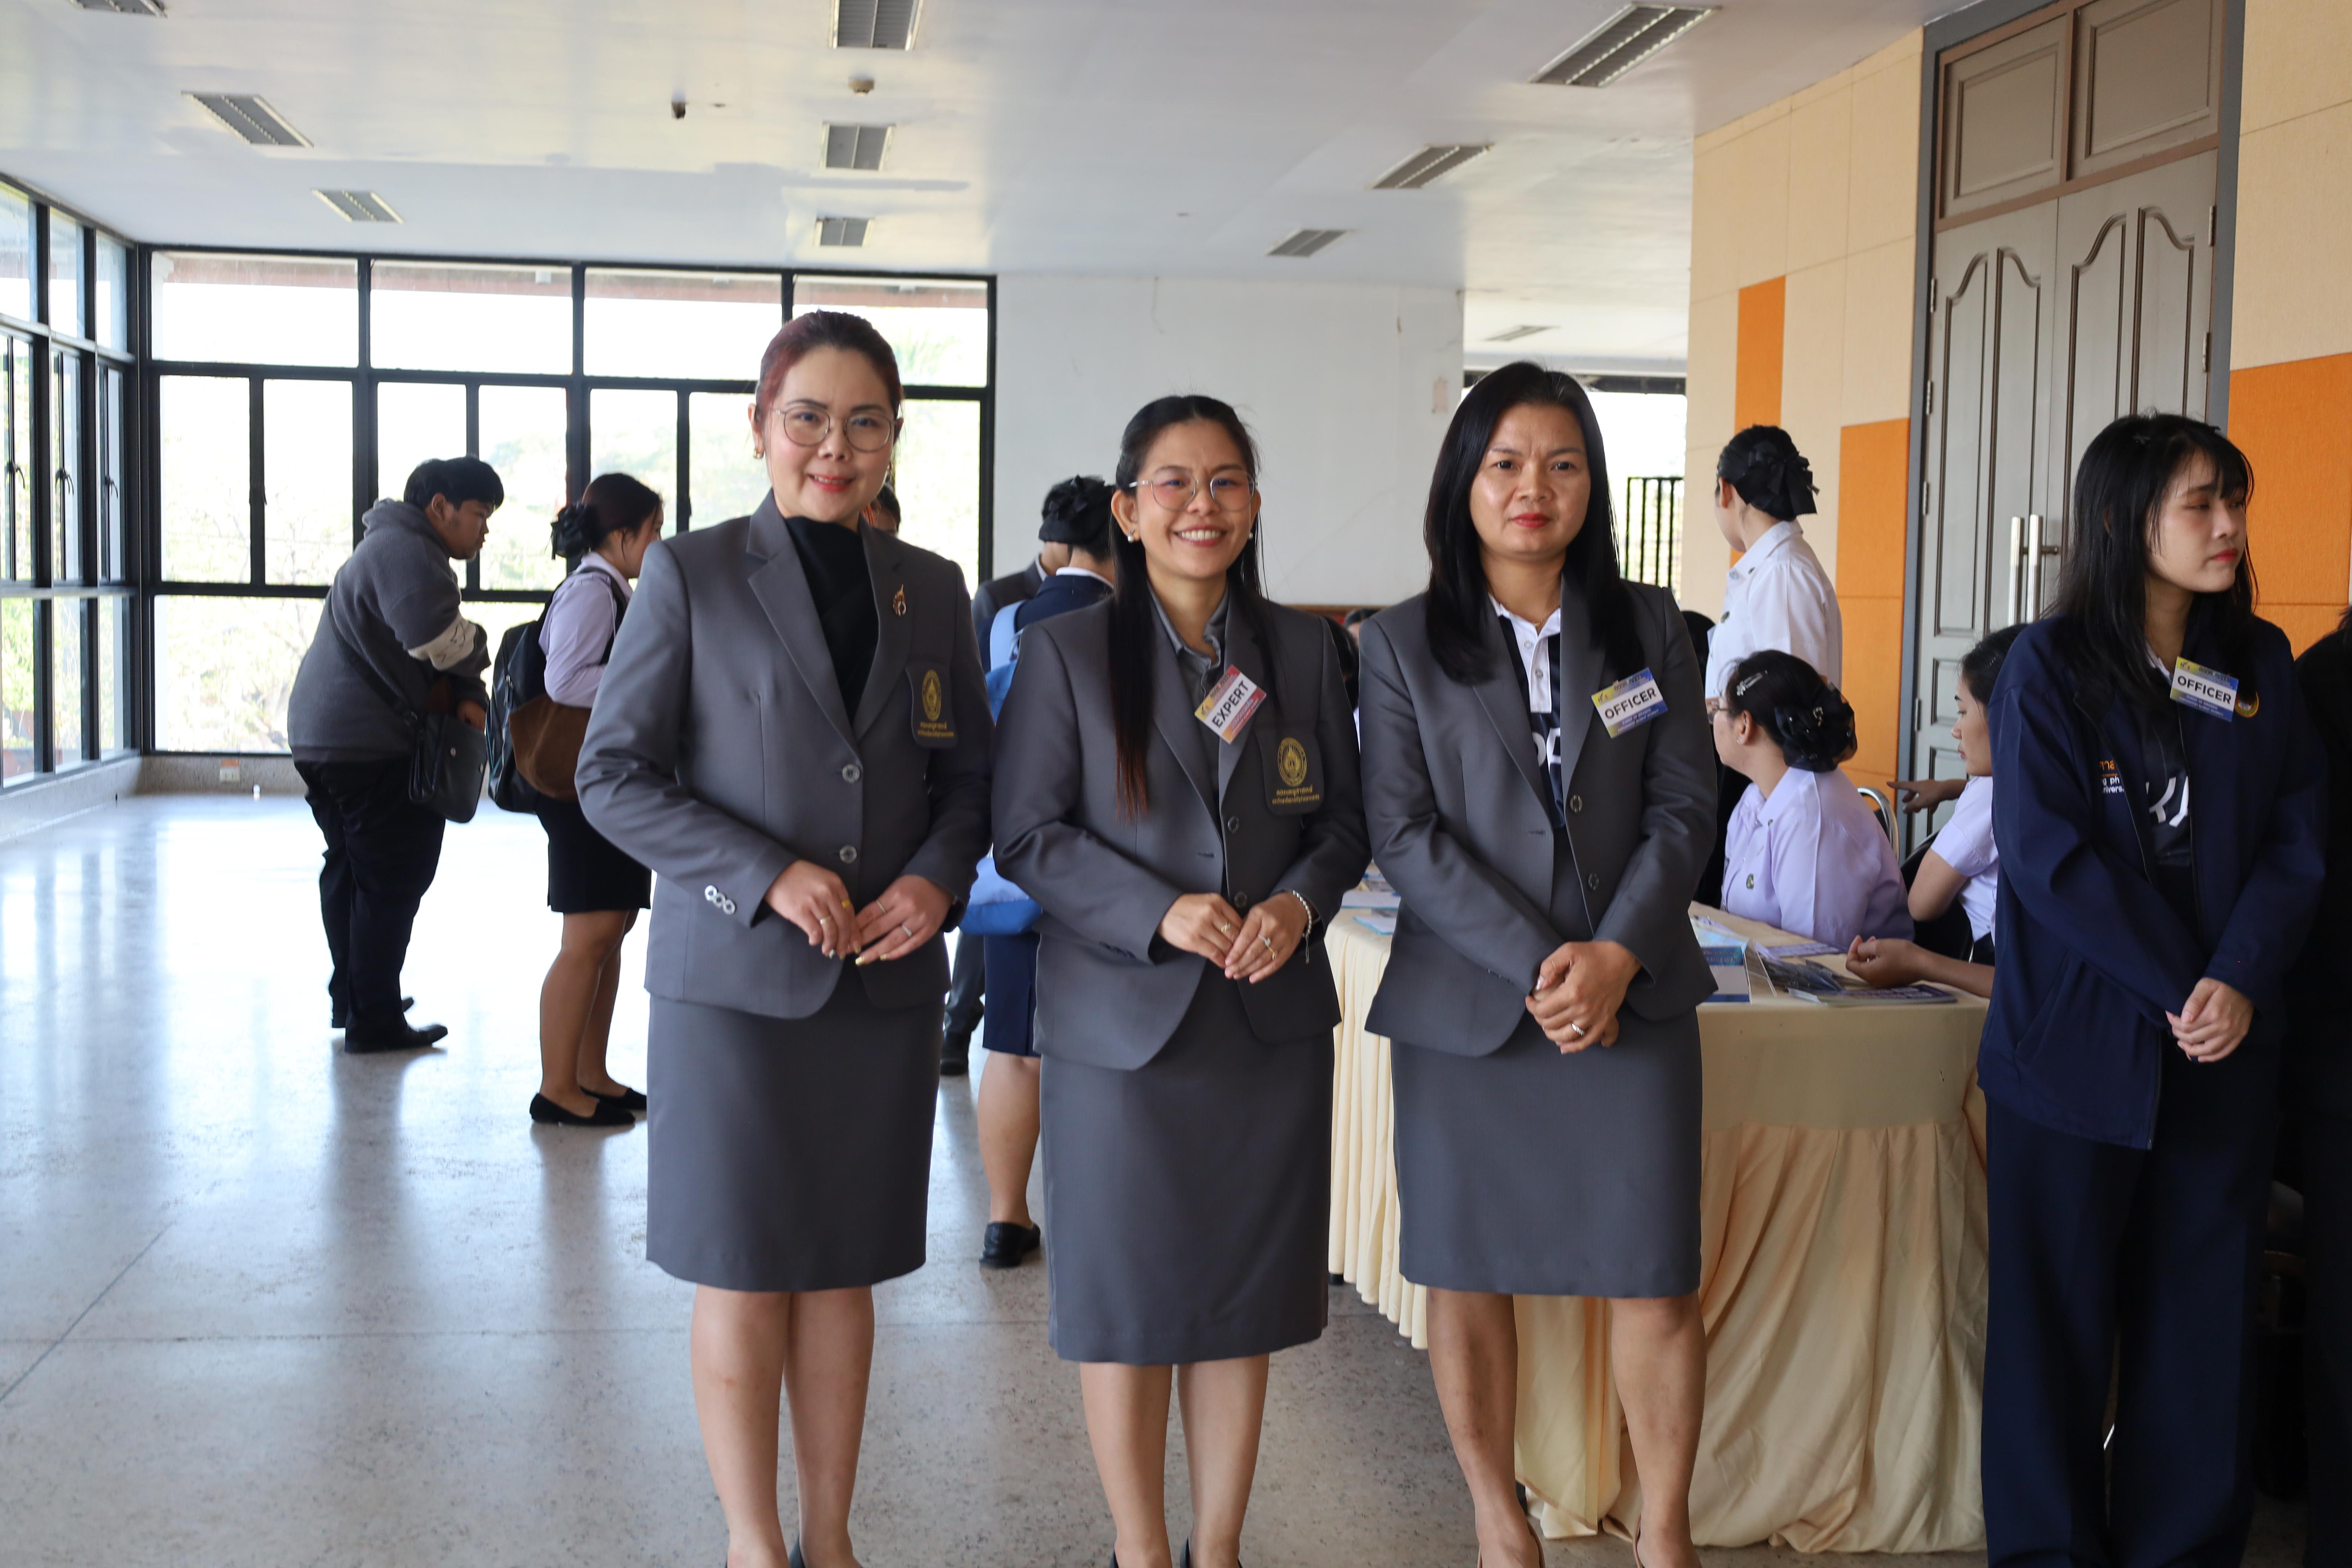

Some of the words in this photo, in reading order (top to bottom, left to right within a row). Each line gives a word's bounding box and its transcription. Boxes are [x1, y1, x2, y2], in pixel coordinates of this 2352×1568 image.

[1212, 681, 1248, 728] EXPERT
[1605, 688, 1657, 719] OFFICER
[2177, 675, 2231, 704] OFFICER
